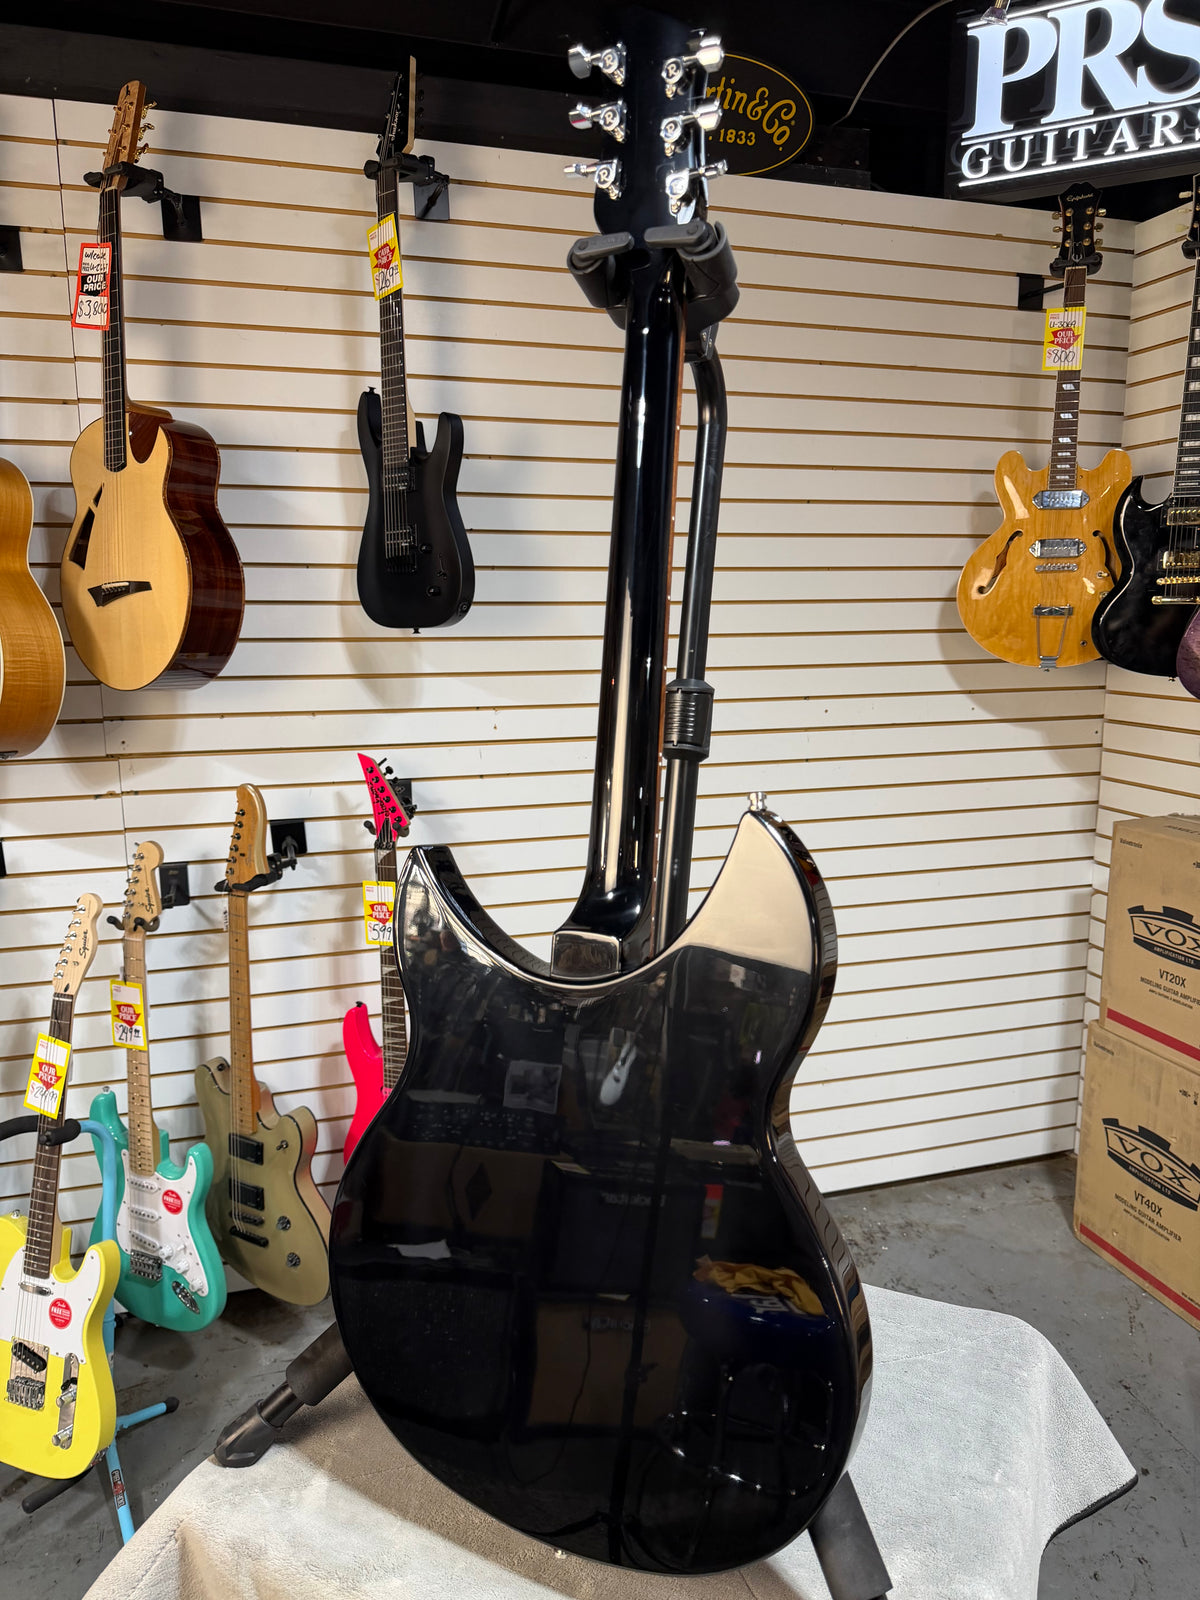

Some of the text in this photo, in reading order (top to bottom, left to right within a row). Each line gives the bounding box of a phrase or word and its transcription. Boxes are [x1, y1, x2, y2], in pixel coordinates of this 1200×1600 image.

[961, 0, 1200, 138] PRS
[719, 129, 756, 146] 1833
[961, 111, 1200, 179] GUITAR
[86, 274, 104, 284] OUR
[83, 282, 107, 292] PRICE
[1057, 330, 1074, 338] OUR
[1047, 348, 1076, 363] $800
[372, 911, 391, 919] PRICE
[1158, 967, 1187, 989] VT20X
[118, 1012, 138, 1022] PRICE
[41, 1063, 56, 1076] OUR
[38, 1070, 58, 1085] PRICE
[1113, 1132, 1192, 1193] VOX
[1134, 1189, 1163, 1218] VT40X
